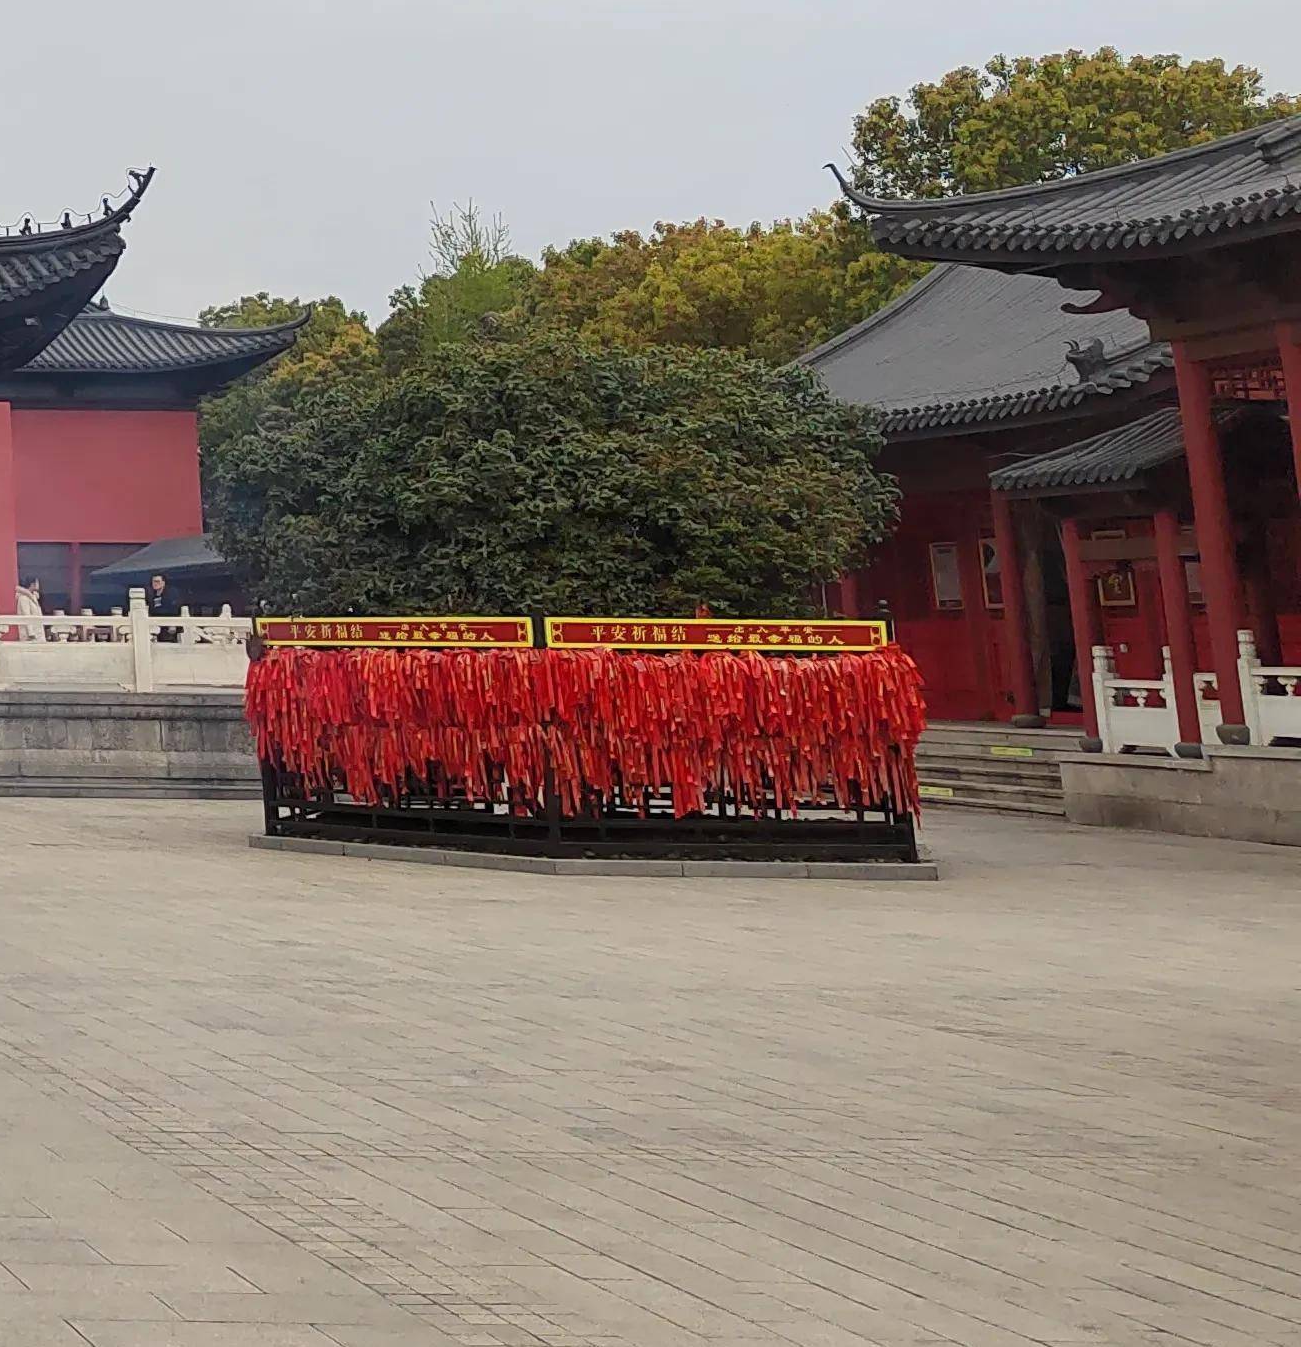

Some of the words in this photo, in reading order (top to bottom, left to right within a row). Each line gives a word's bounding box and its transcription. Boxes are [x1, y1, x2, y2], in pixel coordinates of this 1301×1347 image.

[289, 623, 364, 640] 平安祈福结
[590, 625, 687, 643] 平安祈福结
[705, 633, 846, 645] 送给最幸福的人
